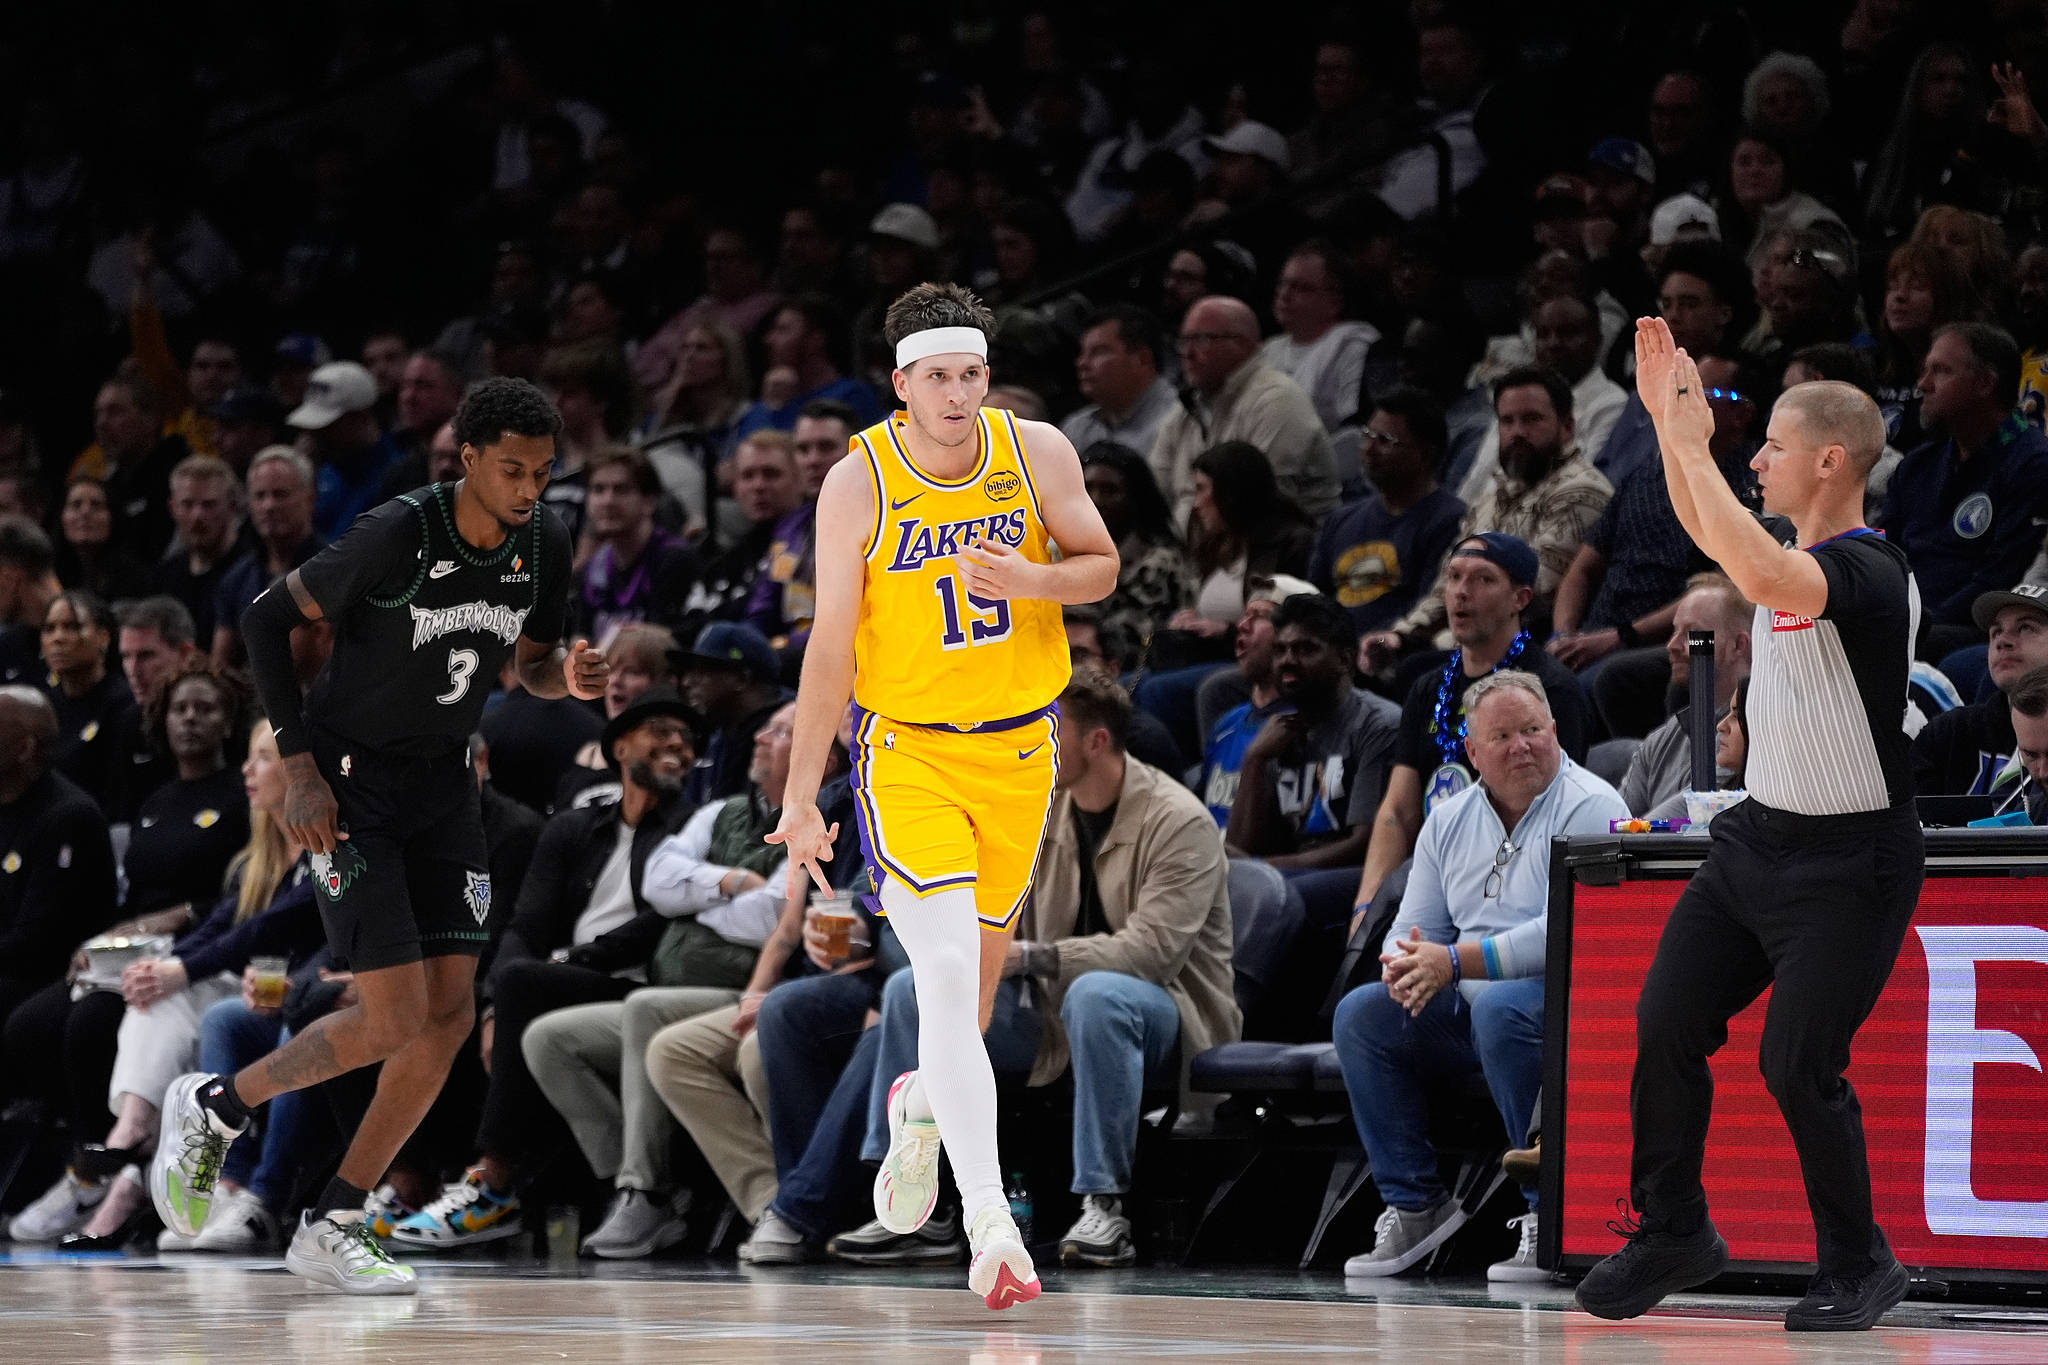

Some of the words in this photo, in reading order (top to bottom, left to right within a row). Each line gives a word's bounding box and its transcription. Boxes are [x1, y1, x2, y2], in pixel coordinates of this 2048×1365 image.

[987, 479, 1018, 492] bibigo
[886, 507, 1027, 573] LAKERS
[434, 560, 455, 572] NIKE
[500, 572, 531, 583] sezzle
[436, 648, 480, 705] 3
